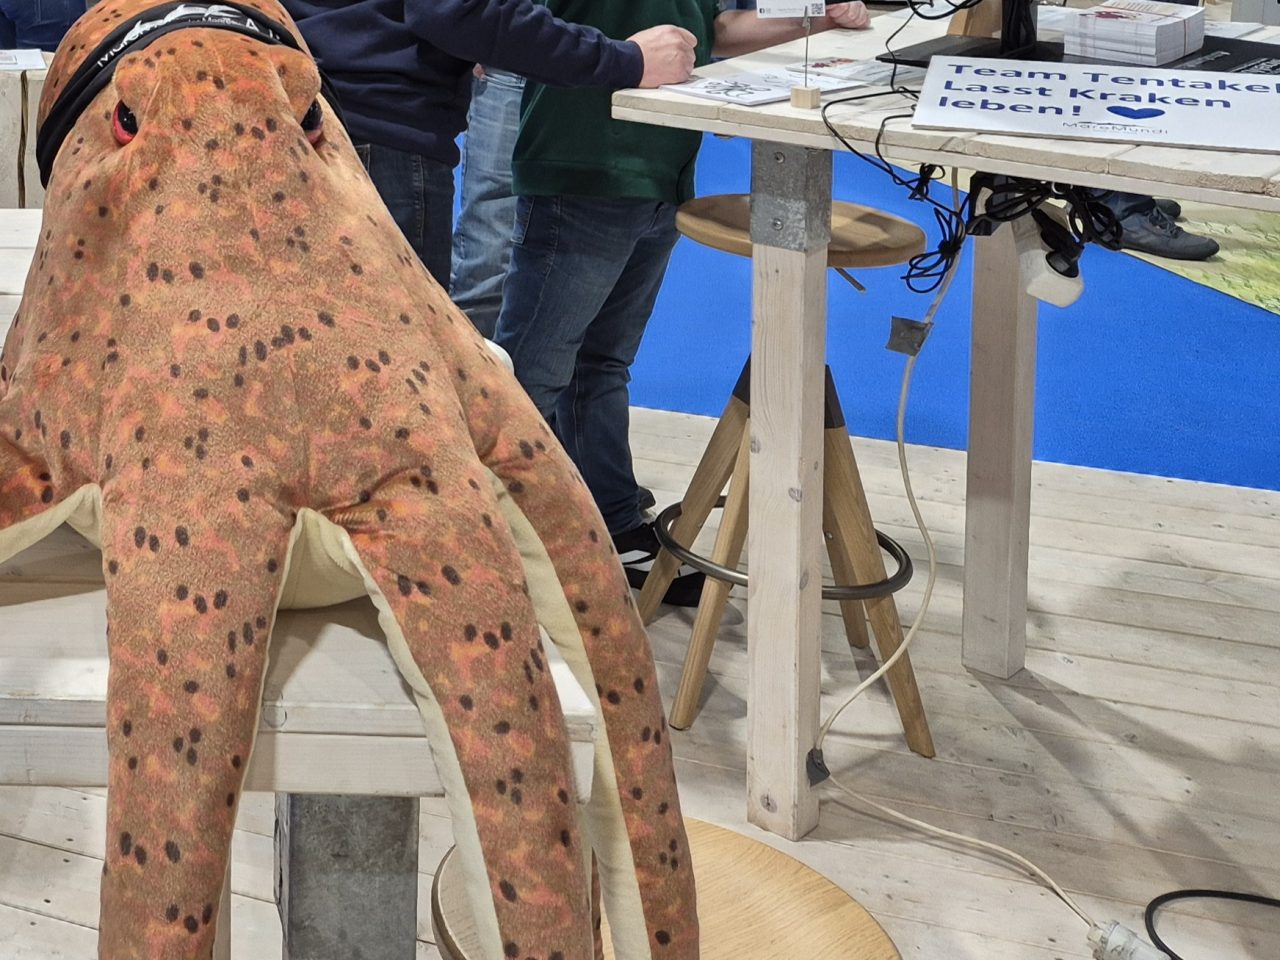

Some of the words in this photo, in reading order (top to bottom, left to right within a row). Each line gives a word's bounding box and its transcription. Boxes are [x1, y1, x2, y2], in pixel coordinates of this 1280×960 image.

[948, 63, 1067, 82] Team
[944, 80, 1053, 98] Lasst
[1069, 88, 1232, 109] Kraken
[938, 96, 1082, 117] leben!
[1062, 122, 1169, 135] MareMundi
